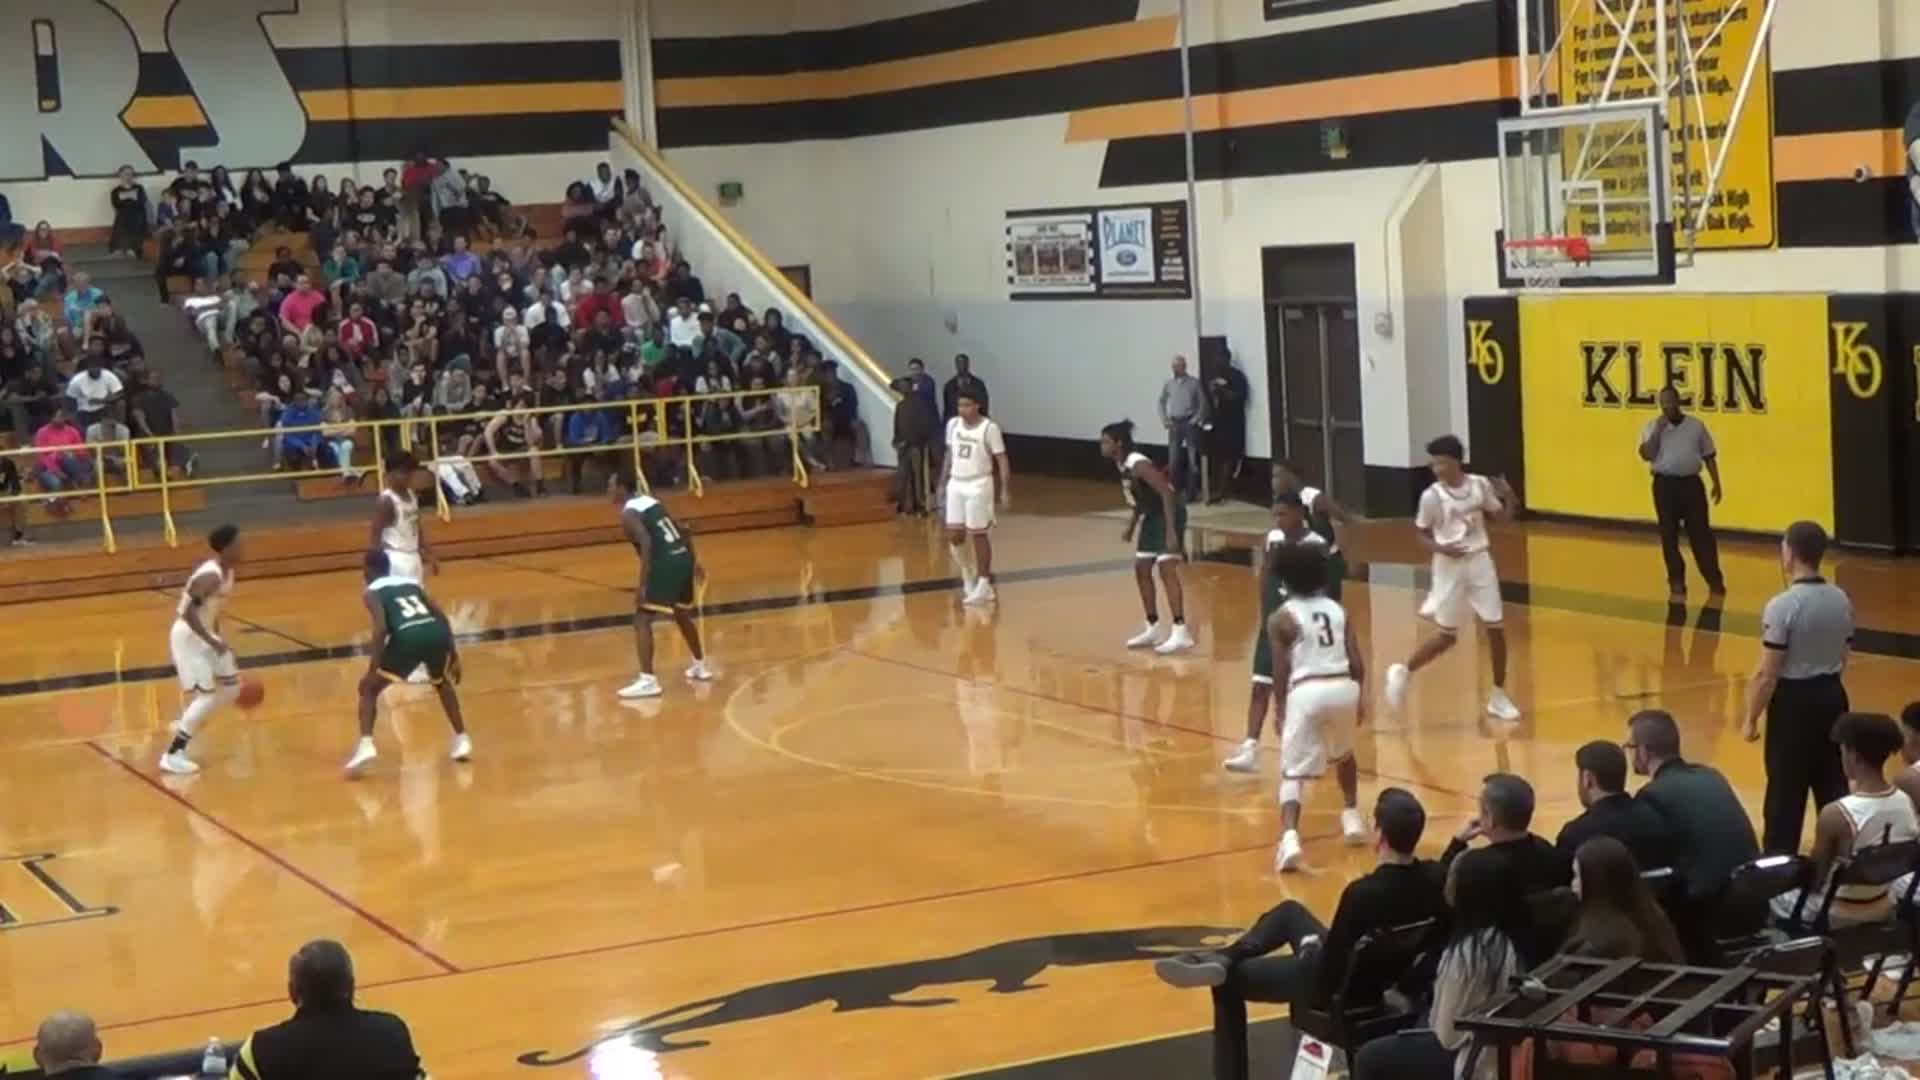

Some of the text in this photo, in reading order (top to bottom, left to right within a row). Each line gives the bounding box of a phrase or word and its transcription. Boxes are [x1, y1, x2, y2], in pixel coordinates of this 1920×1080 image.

[1103, 216, 1145, 250] PLANET
[1580, 341, 1767, 414] KLEIN
[1312, 611, 1334, 648] 3
